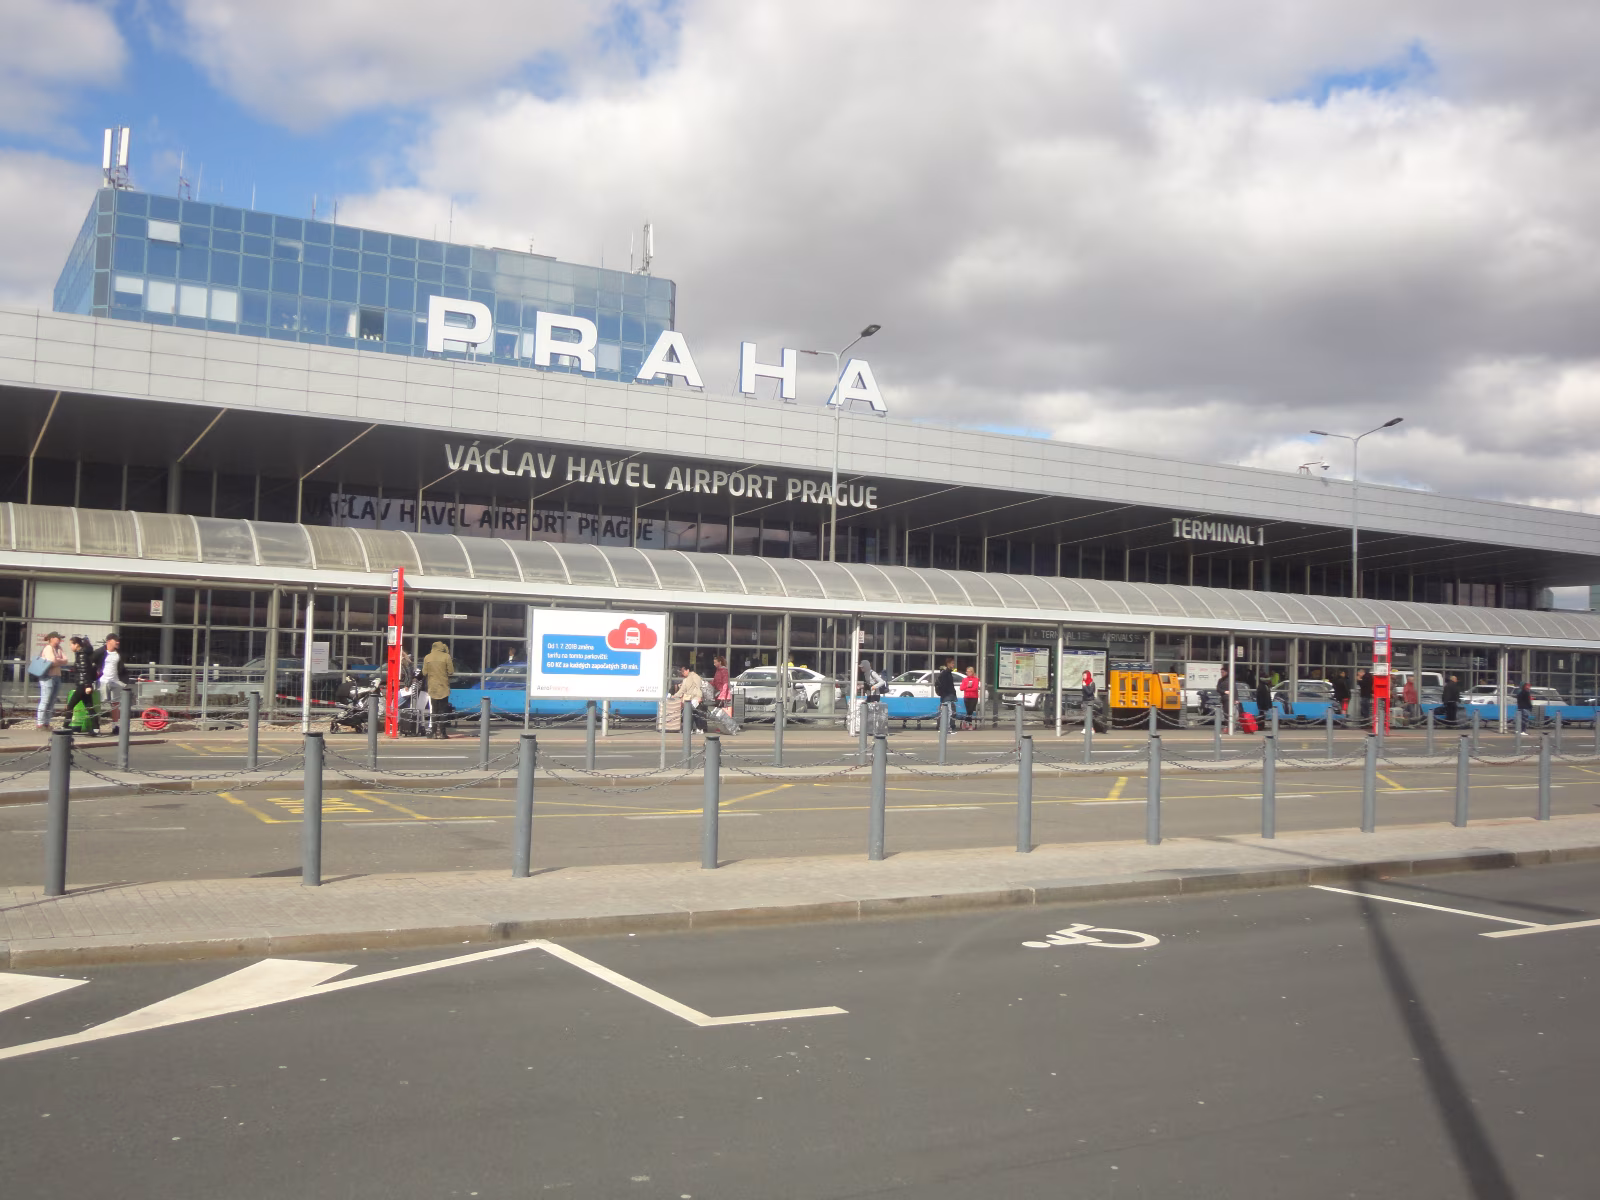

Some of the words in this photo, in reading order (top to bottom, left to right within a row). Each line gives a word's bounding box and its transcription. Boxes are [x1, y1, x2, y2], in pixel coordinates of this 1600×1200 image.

[427, 295, 888, 413] PRAHA
[445, 441, 556, 478] VÁCLAV
[566, 456, 656, 488] HAVEL
[665, 466, 777, 499] AIRPORT
[785, 478, 878, 509] PRAGUE
[1172, 518, 1255, 545] TERMINAL
[1257, 527, 1265, 547] 1
[1041, 629, 1076, 640] TERMNAL
